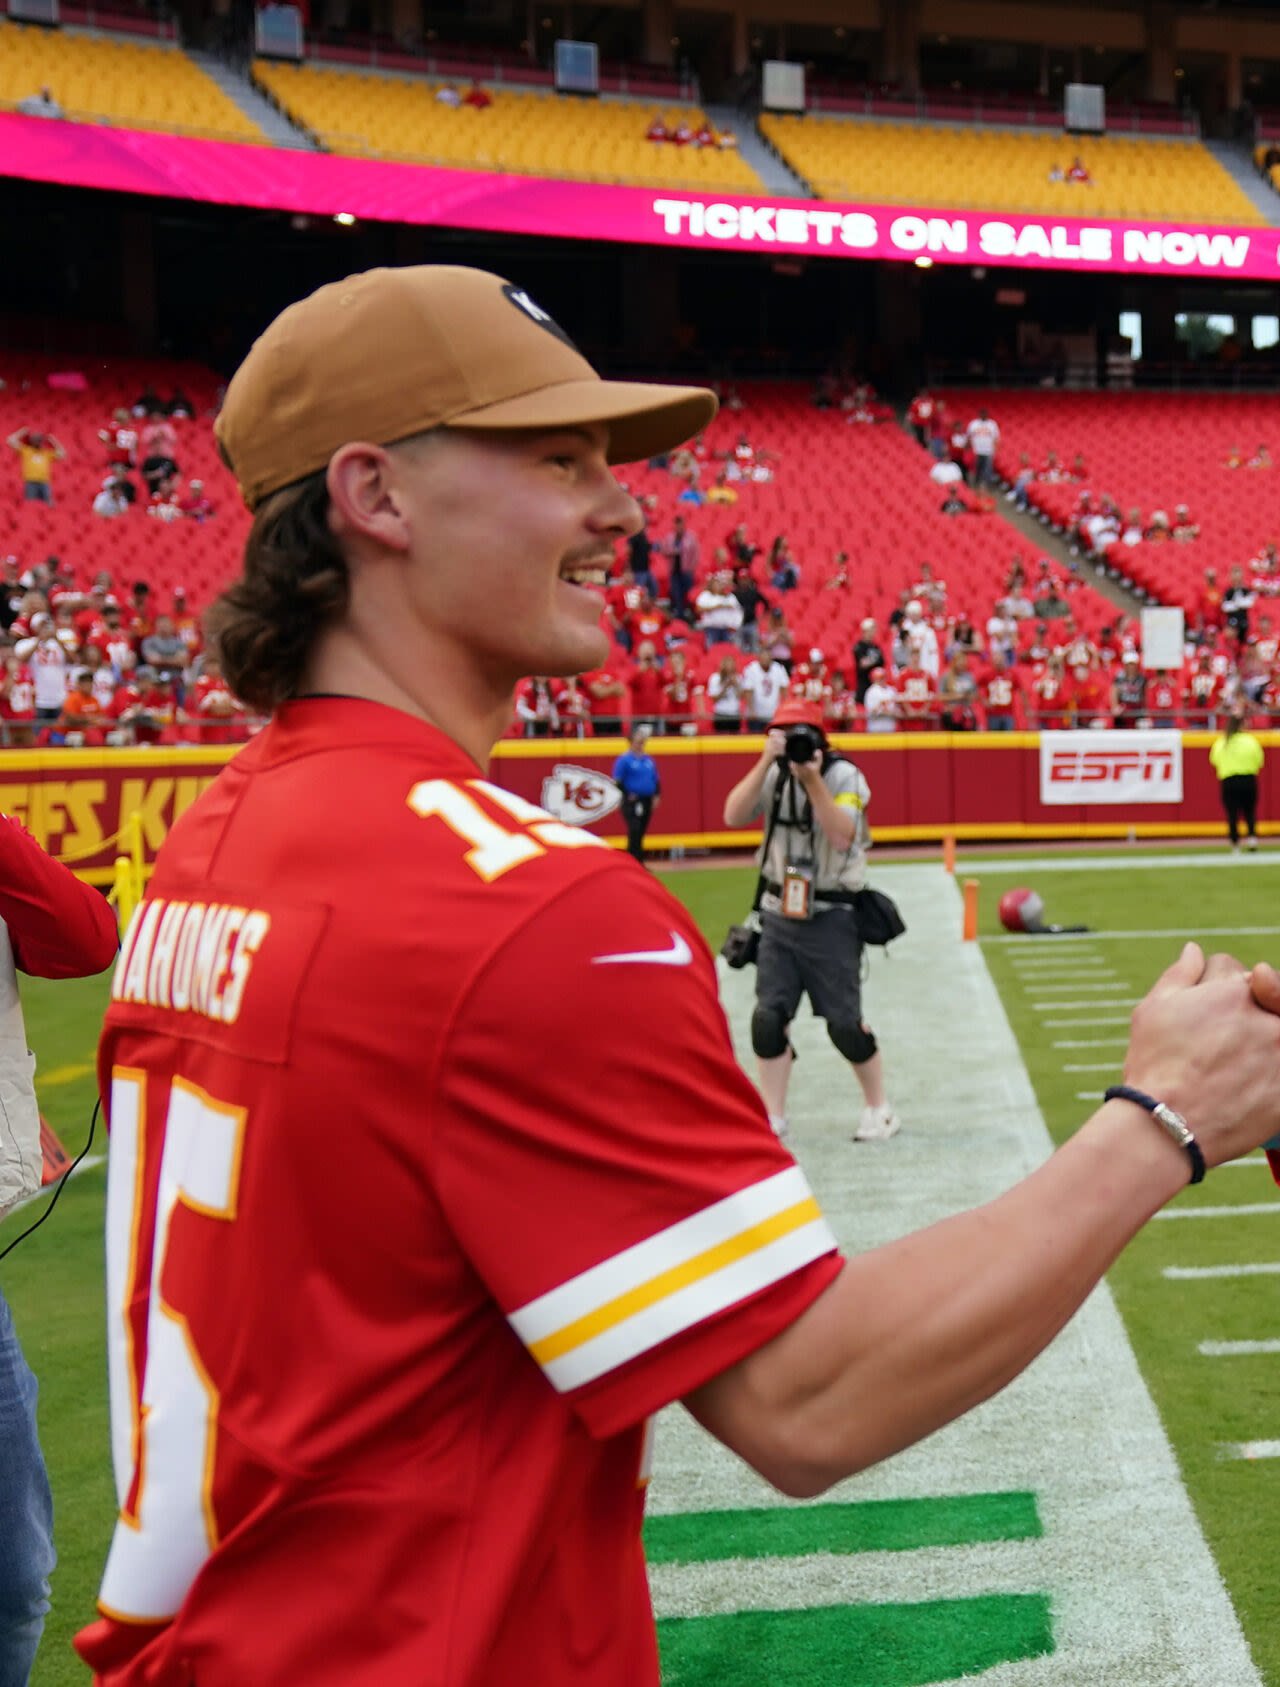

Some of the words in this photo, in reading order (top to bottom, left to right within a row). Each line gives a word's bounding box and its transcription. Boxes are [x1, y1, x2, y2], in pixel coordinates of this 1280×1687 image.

[653, 198, 878, 248] TICKETS
[890, 216, 968, 252] ON
[979, 221, 1112, 261] SALE
[1123, 229, 1250, 267] NOW
[1051, 752, 1172, 782] ESPN
[117, 776, 218, 852] KI
[98, 1064, 248, 1626] 15
